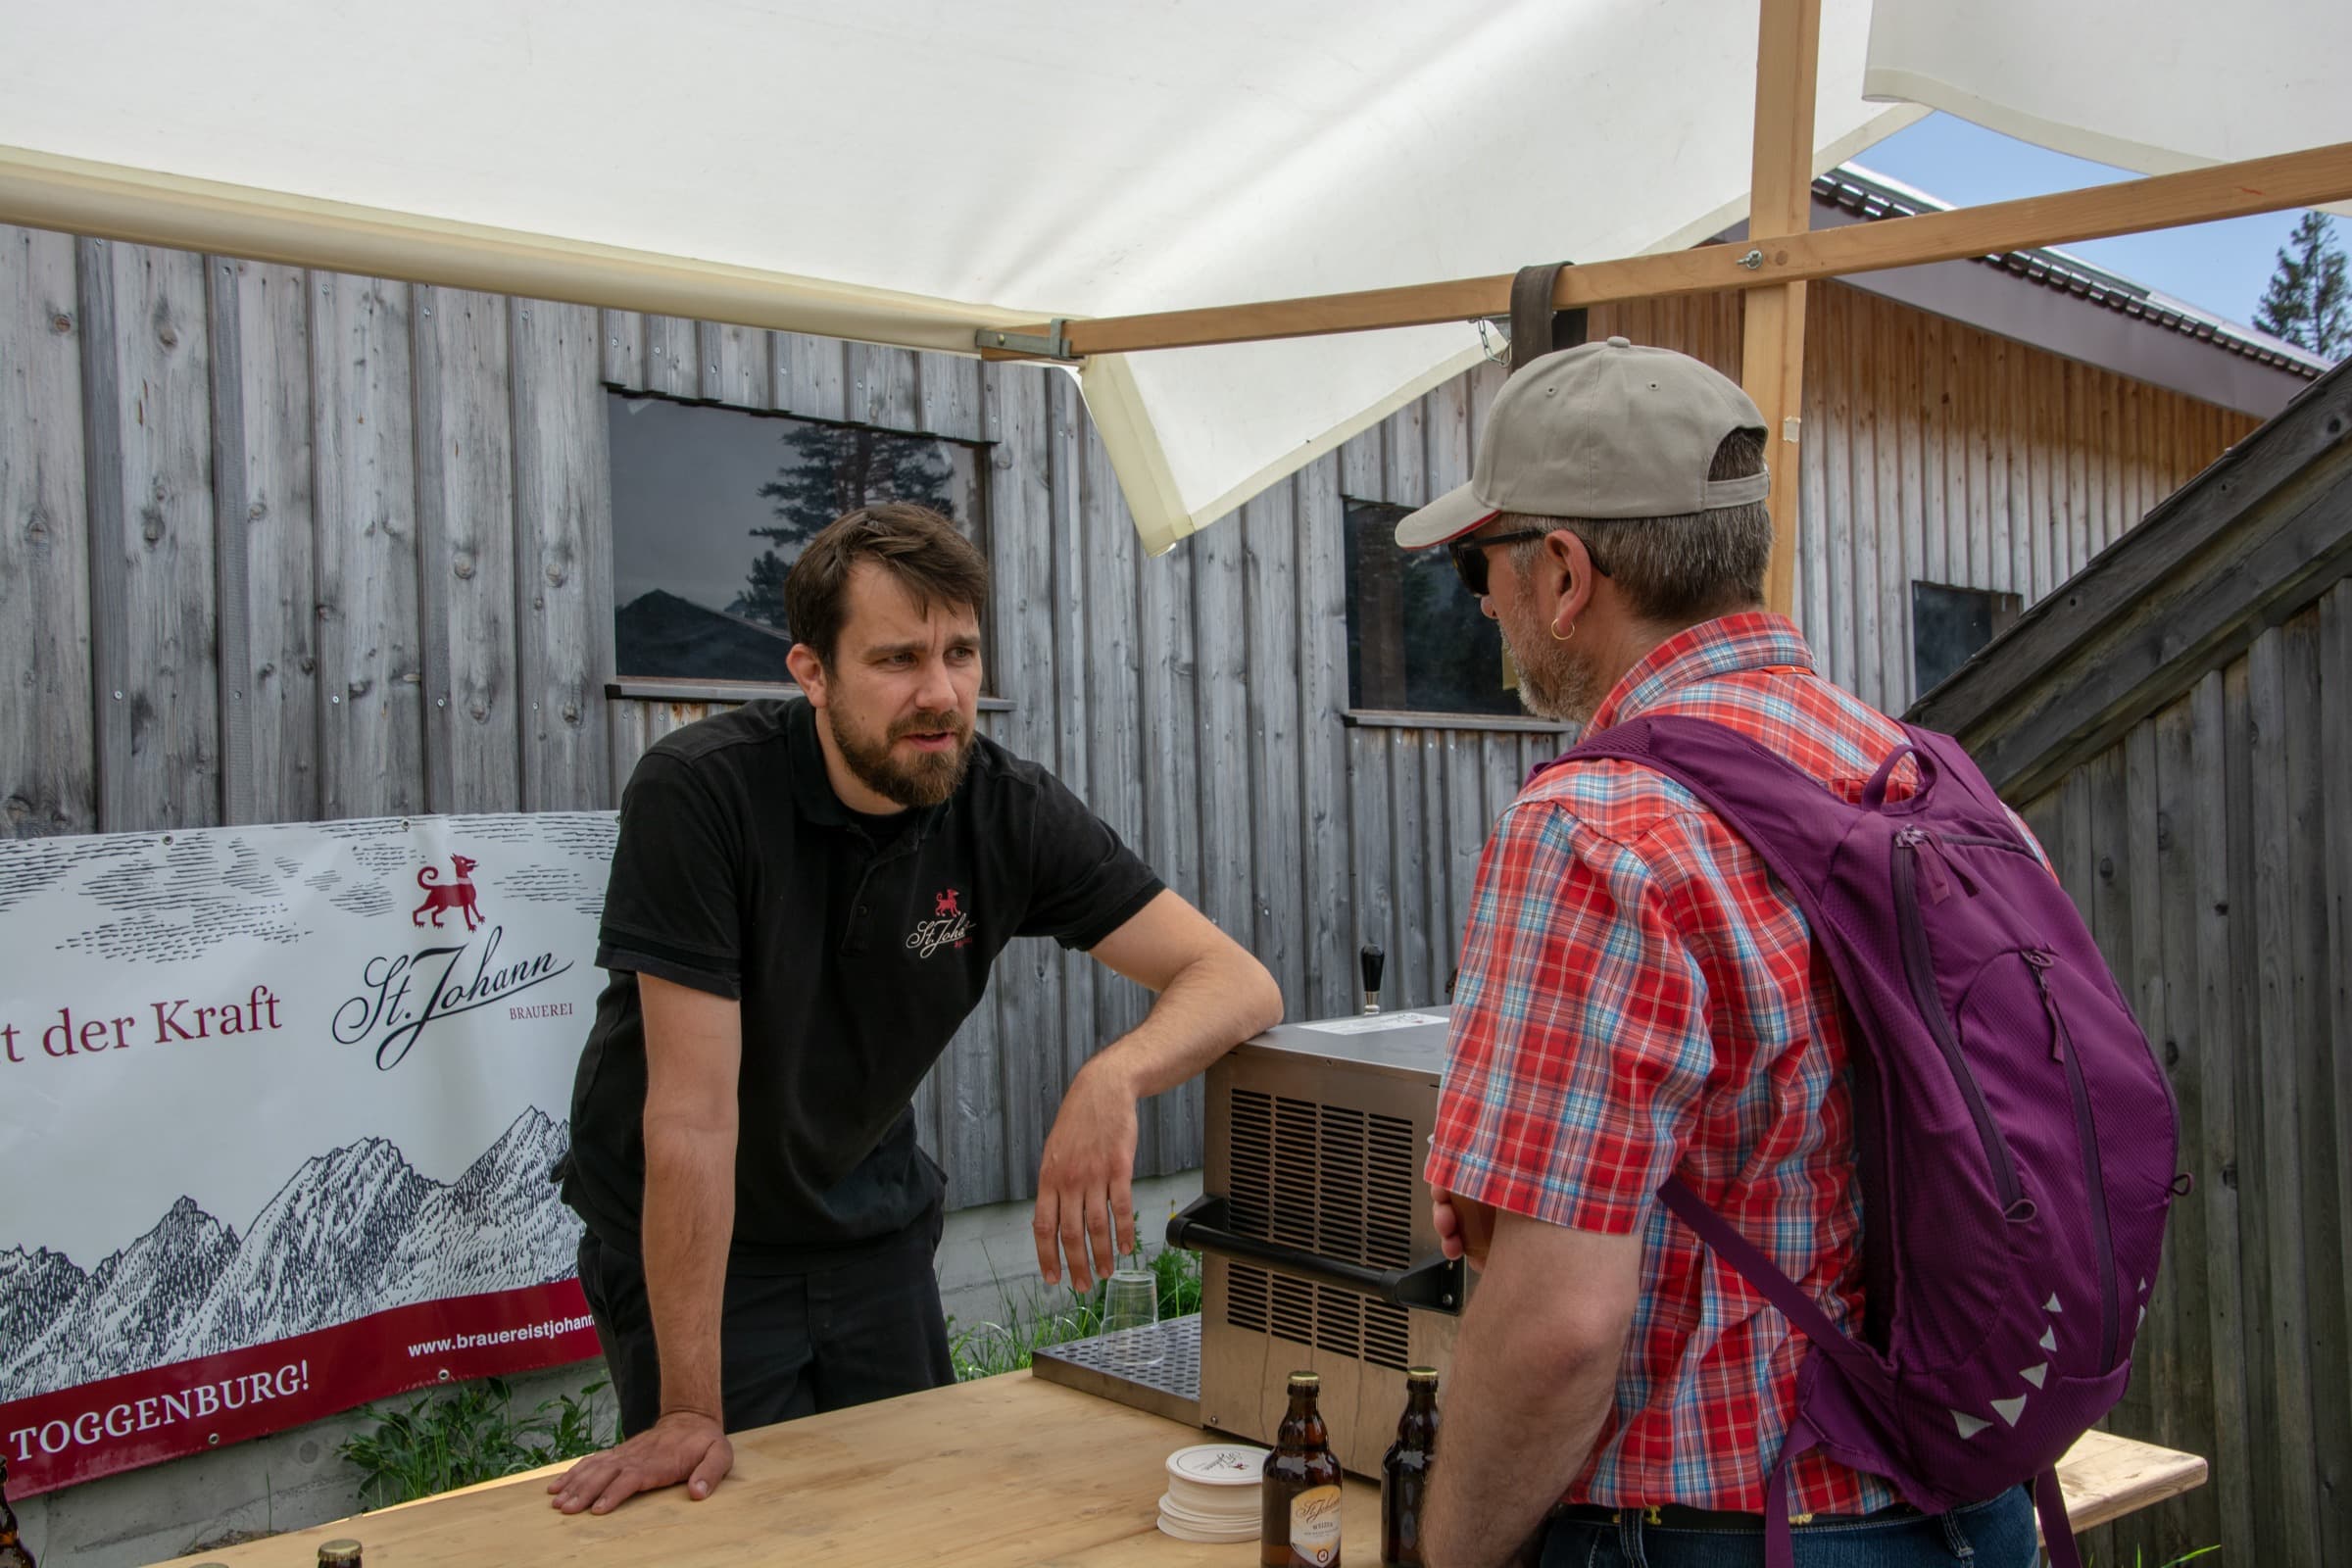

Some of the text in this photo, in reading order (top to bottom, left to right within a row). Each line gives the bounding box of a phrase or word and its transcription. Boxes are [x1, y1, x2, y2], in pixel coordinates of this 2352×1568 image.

[920, 912, 977, 958] Joha
[0, 984, 283, 1063] t der Kraft
[376, 925, 575, 1072] Johann
[509, 1002, 574, 1021] BRAUEREI
[9, 1359, 311, 1462] TOGGENBURG!
